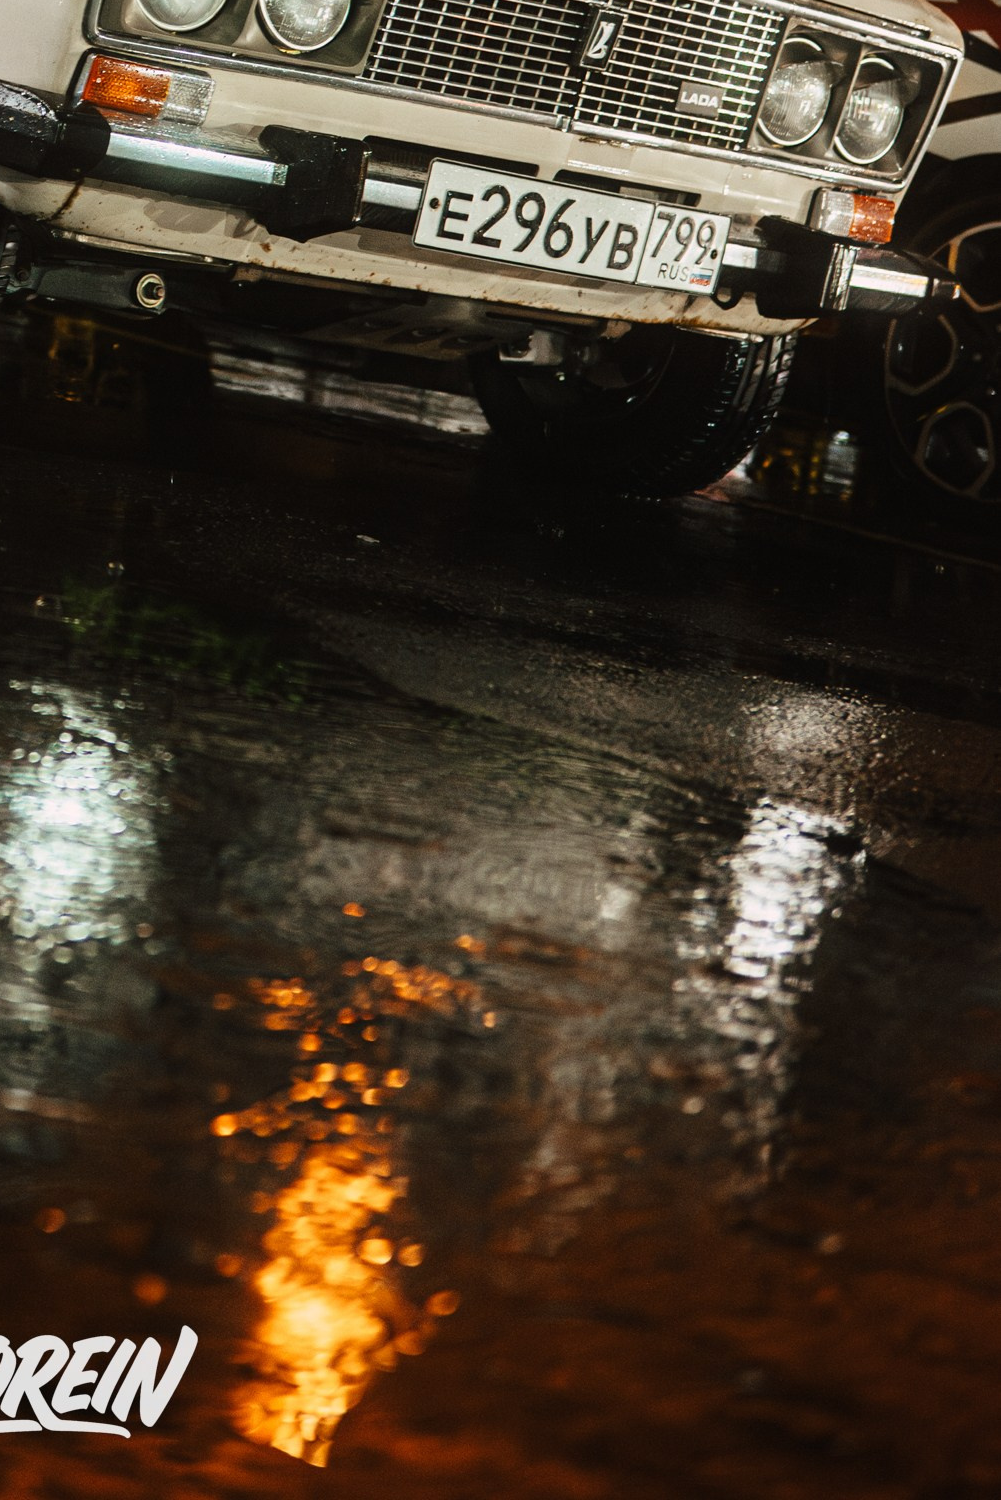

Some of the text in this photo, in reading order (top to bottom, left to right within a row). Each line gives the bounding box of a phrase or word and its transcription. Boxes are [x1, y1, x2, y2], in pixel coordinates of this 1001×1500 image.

[679, 90, 719, 109] LADA
[651, 211, 717, 265] 799
[657, 263, 689, 282] RUS
